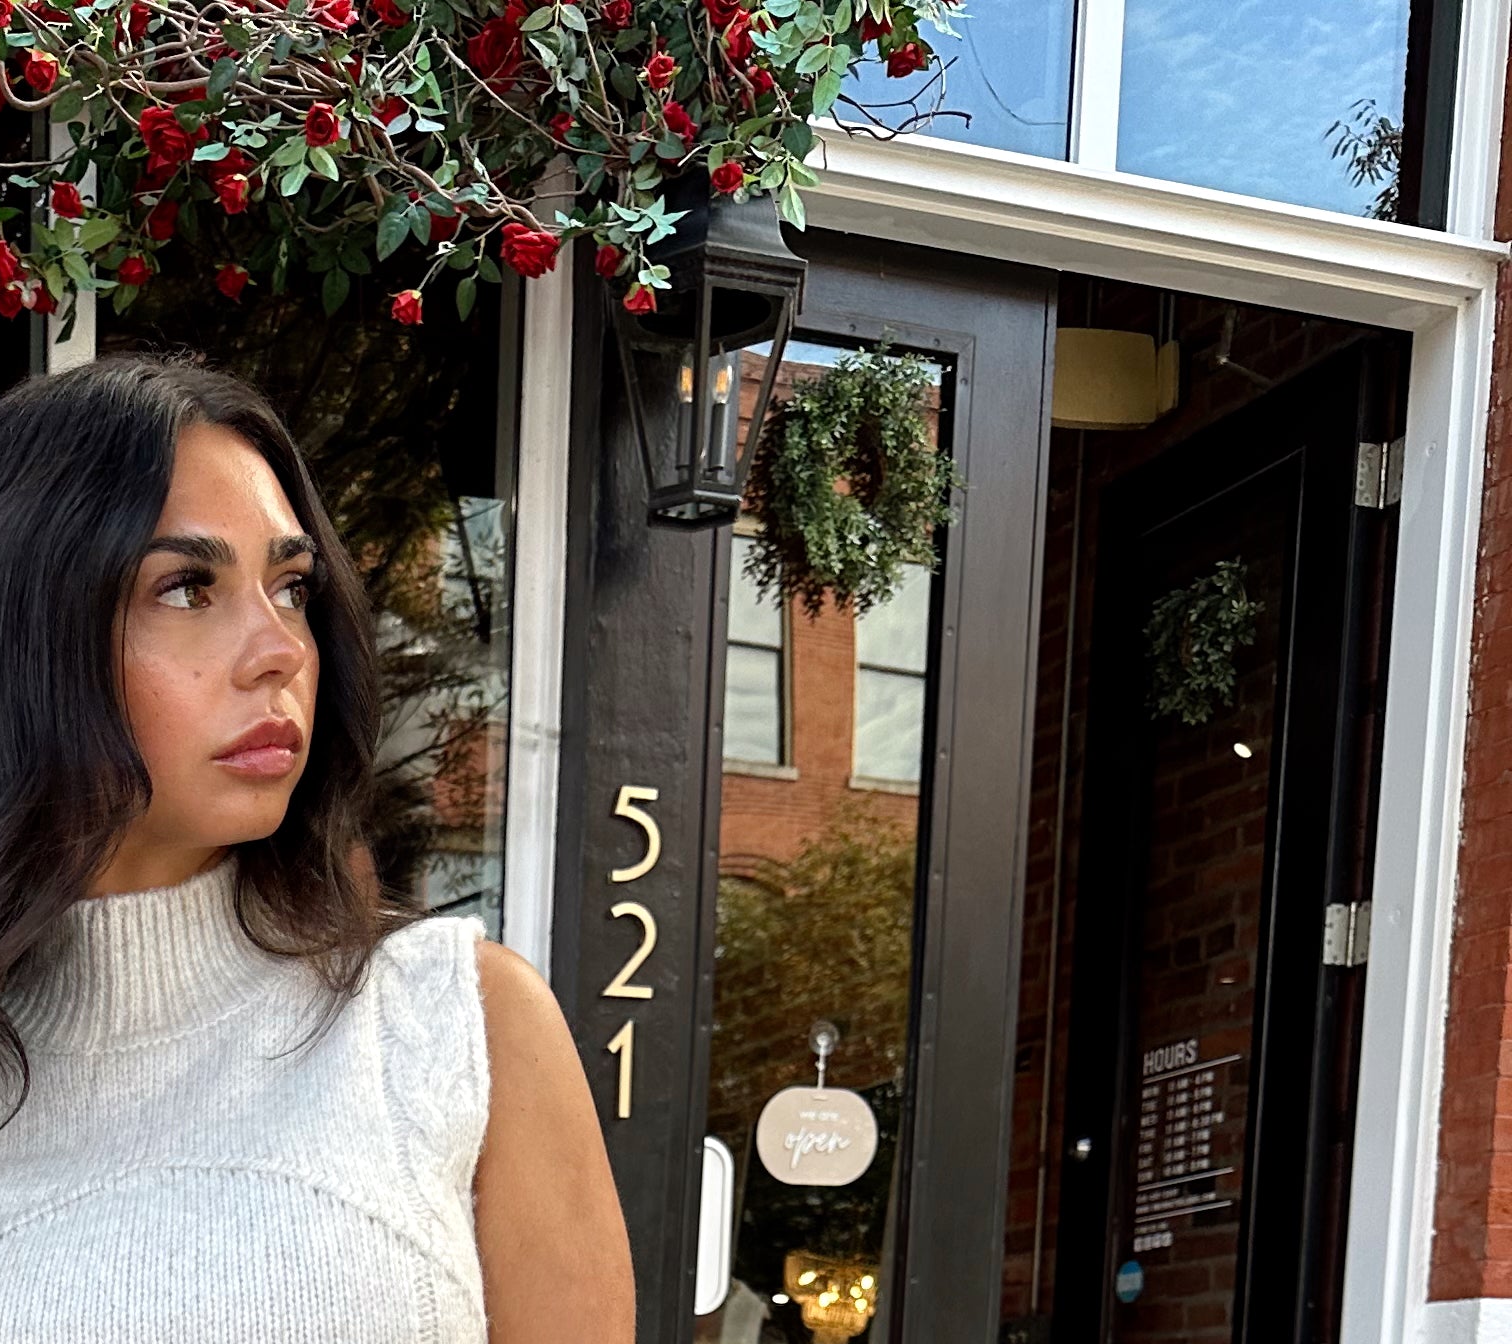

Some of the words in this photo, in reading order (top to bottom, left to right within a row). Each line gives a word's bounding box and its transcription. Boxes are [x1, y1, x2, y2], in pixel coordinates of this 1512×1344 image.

[602, 785, 661, 1120] 521
[1143, 1039, 1198, 1077] HOURS
[799, 1110, 816, 1121] we
[784, 1127, 852, 1169] open
